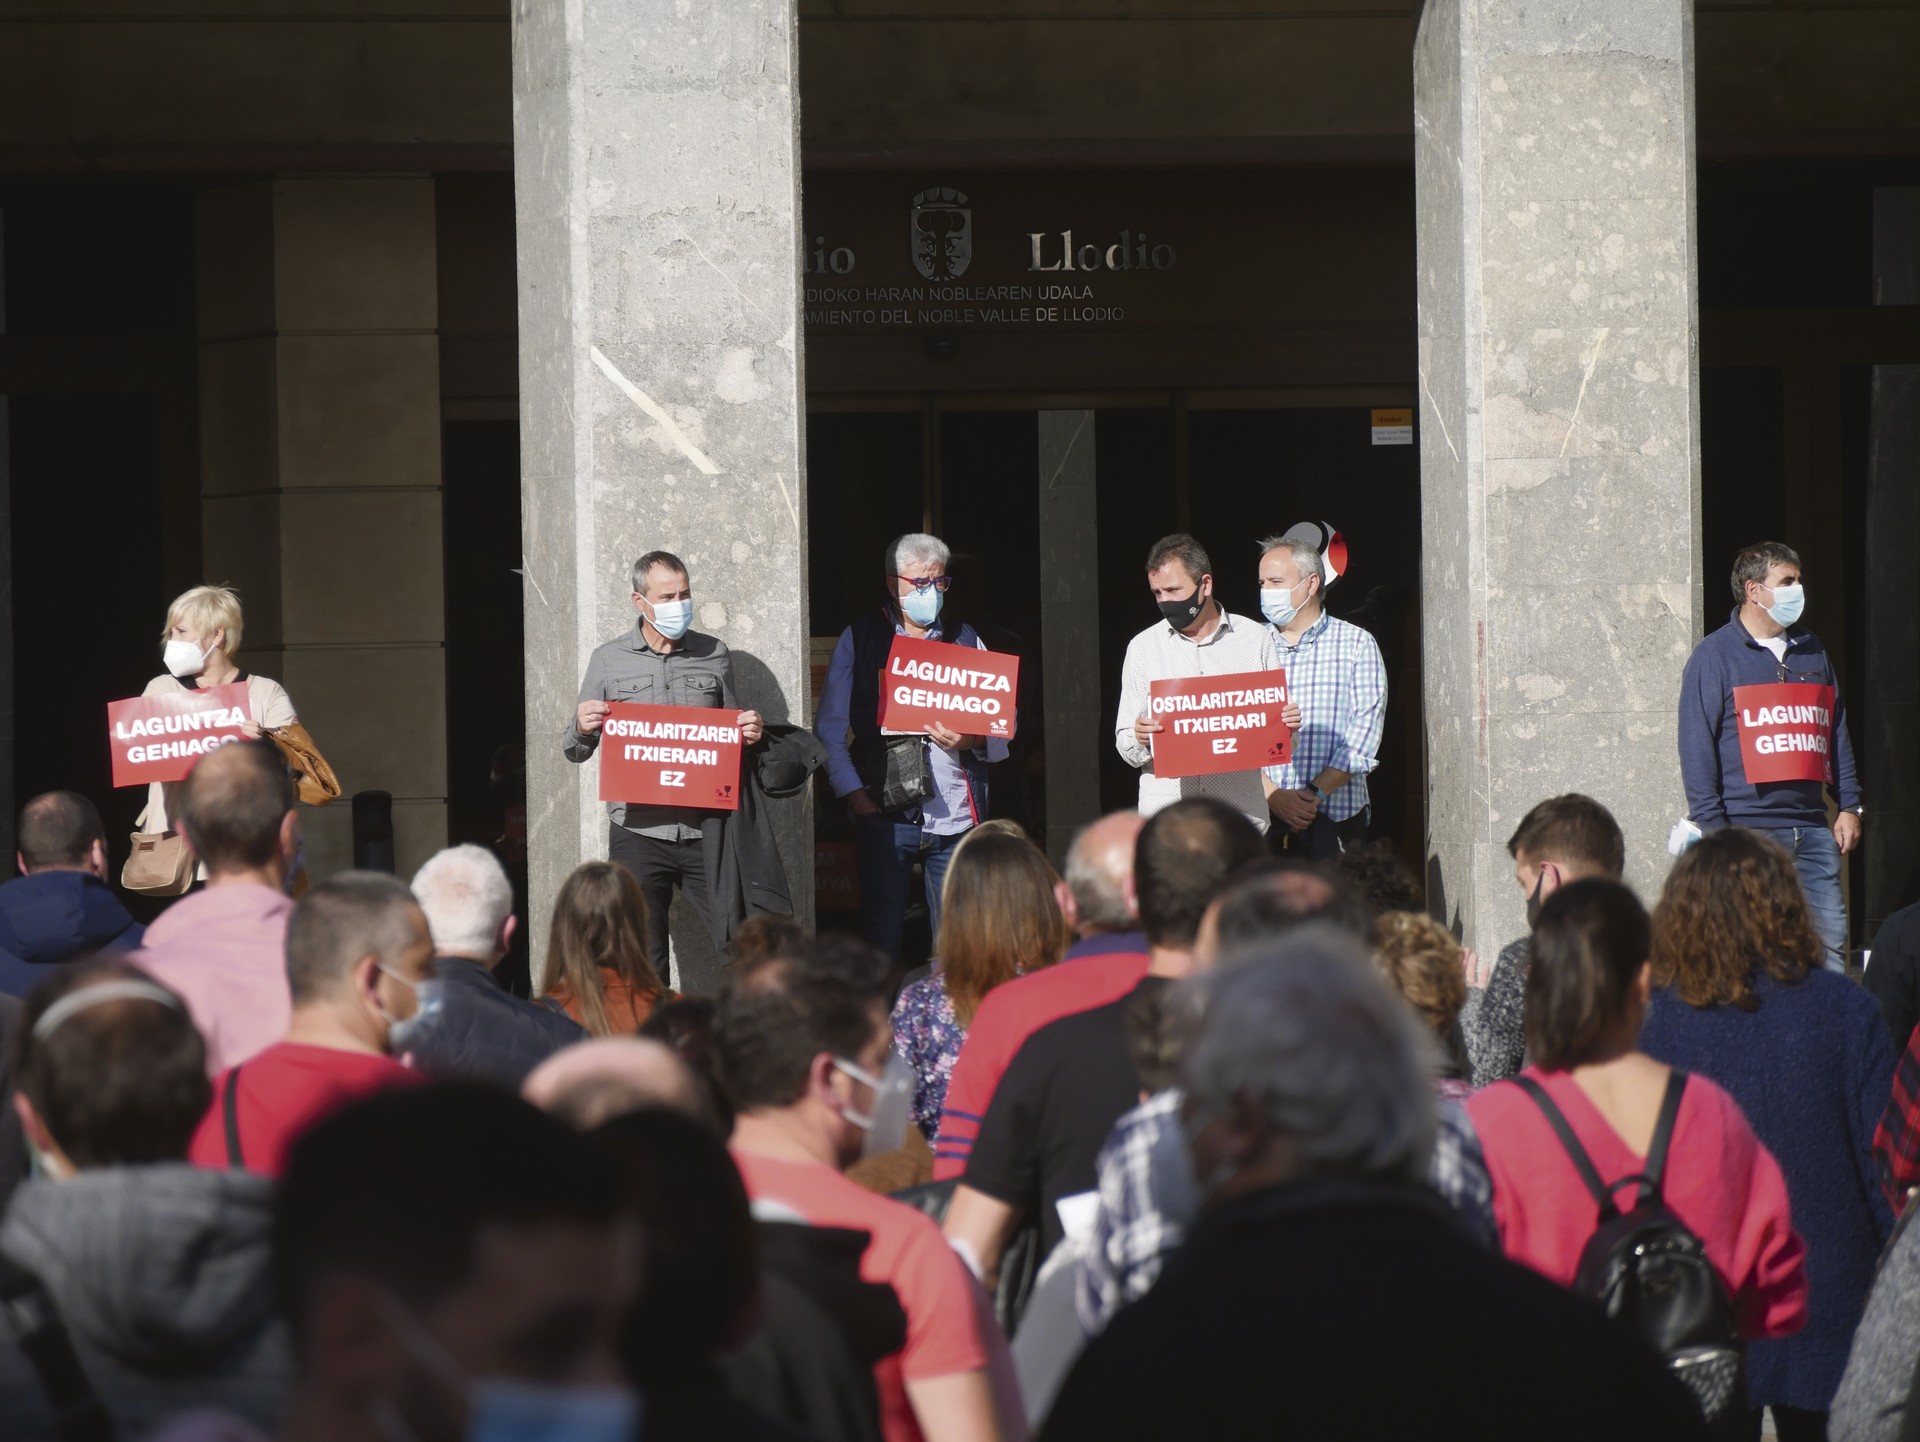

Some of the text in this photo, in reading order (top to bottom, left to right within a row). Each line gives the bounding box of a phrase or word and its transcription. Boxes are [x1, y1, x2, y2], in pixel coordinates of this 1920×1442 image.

[1026, 229, 1178, 272] Llodio
[802, 285, 1093, 303] DIOKO HARAN NOBLEAREN UDALA
[880, 309, 913, 324] DEL
[918, 308, 975, 324] NOBLE
[979, 308, 1031, 323] VALLE
[1036, 307, 1059, 322] DE
[1063, 306, 1125, 322] LLODIO
[891, 656, 1011, 693] LAGUNTZA
[893, 686, 1001, 715] GEHIAGO
[1152, 686, 1286, 714] OSTALARITZAREN
[116, 706, 246, 740] LAGUNTZA
[1174, 712, 1267, 735] ITXIERARI
[1743, 705, 1830, 728] LAGUNTZA
[604, 719, 739, 744] OSTALARITZAREN
[624, 744, 718, 766] ITXIERARI
[1212, 738, 1238, 755] EZ
[1755, 733, 1827, 755] GEHIAGO
[659, 771, 686, 787] EZ
